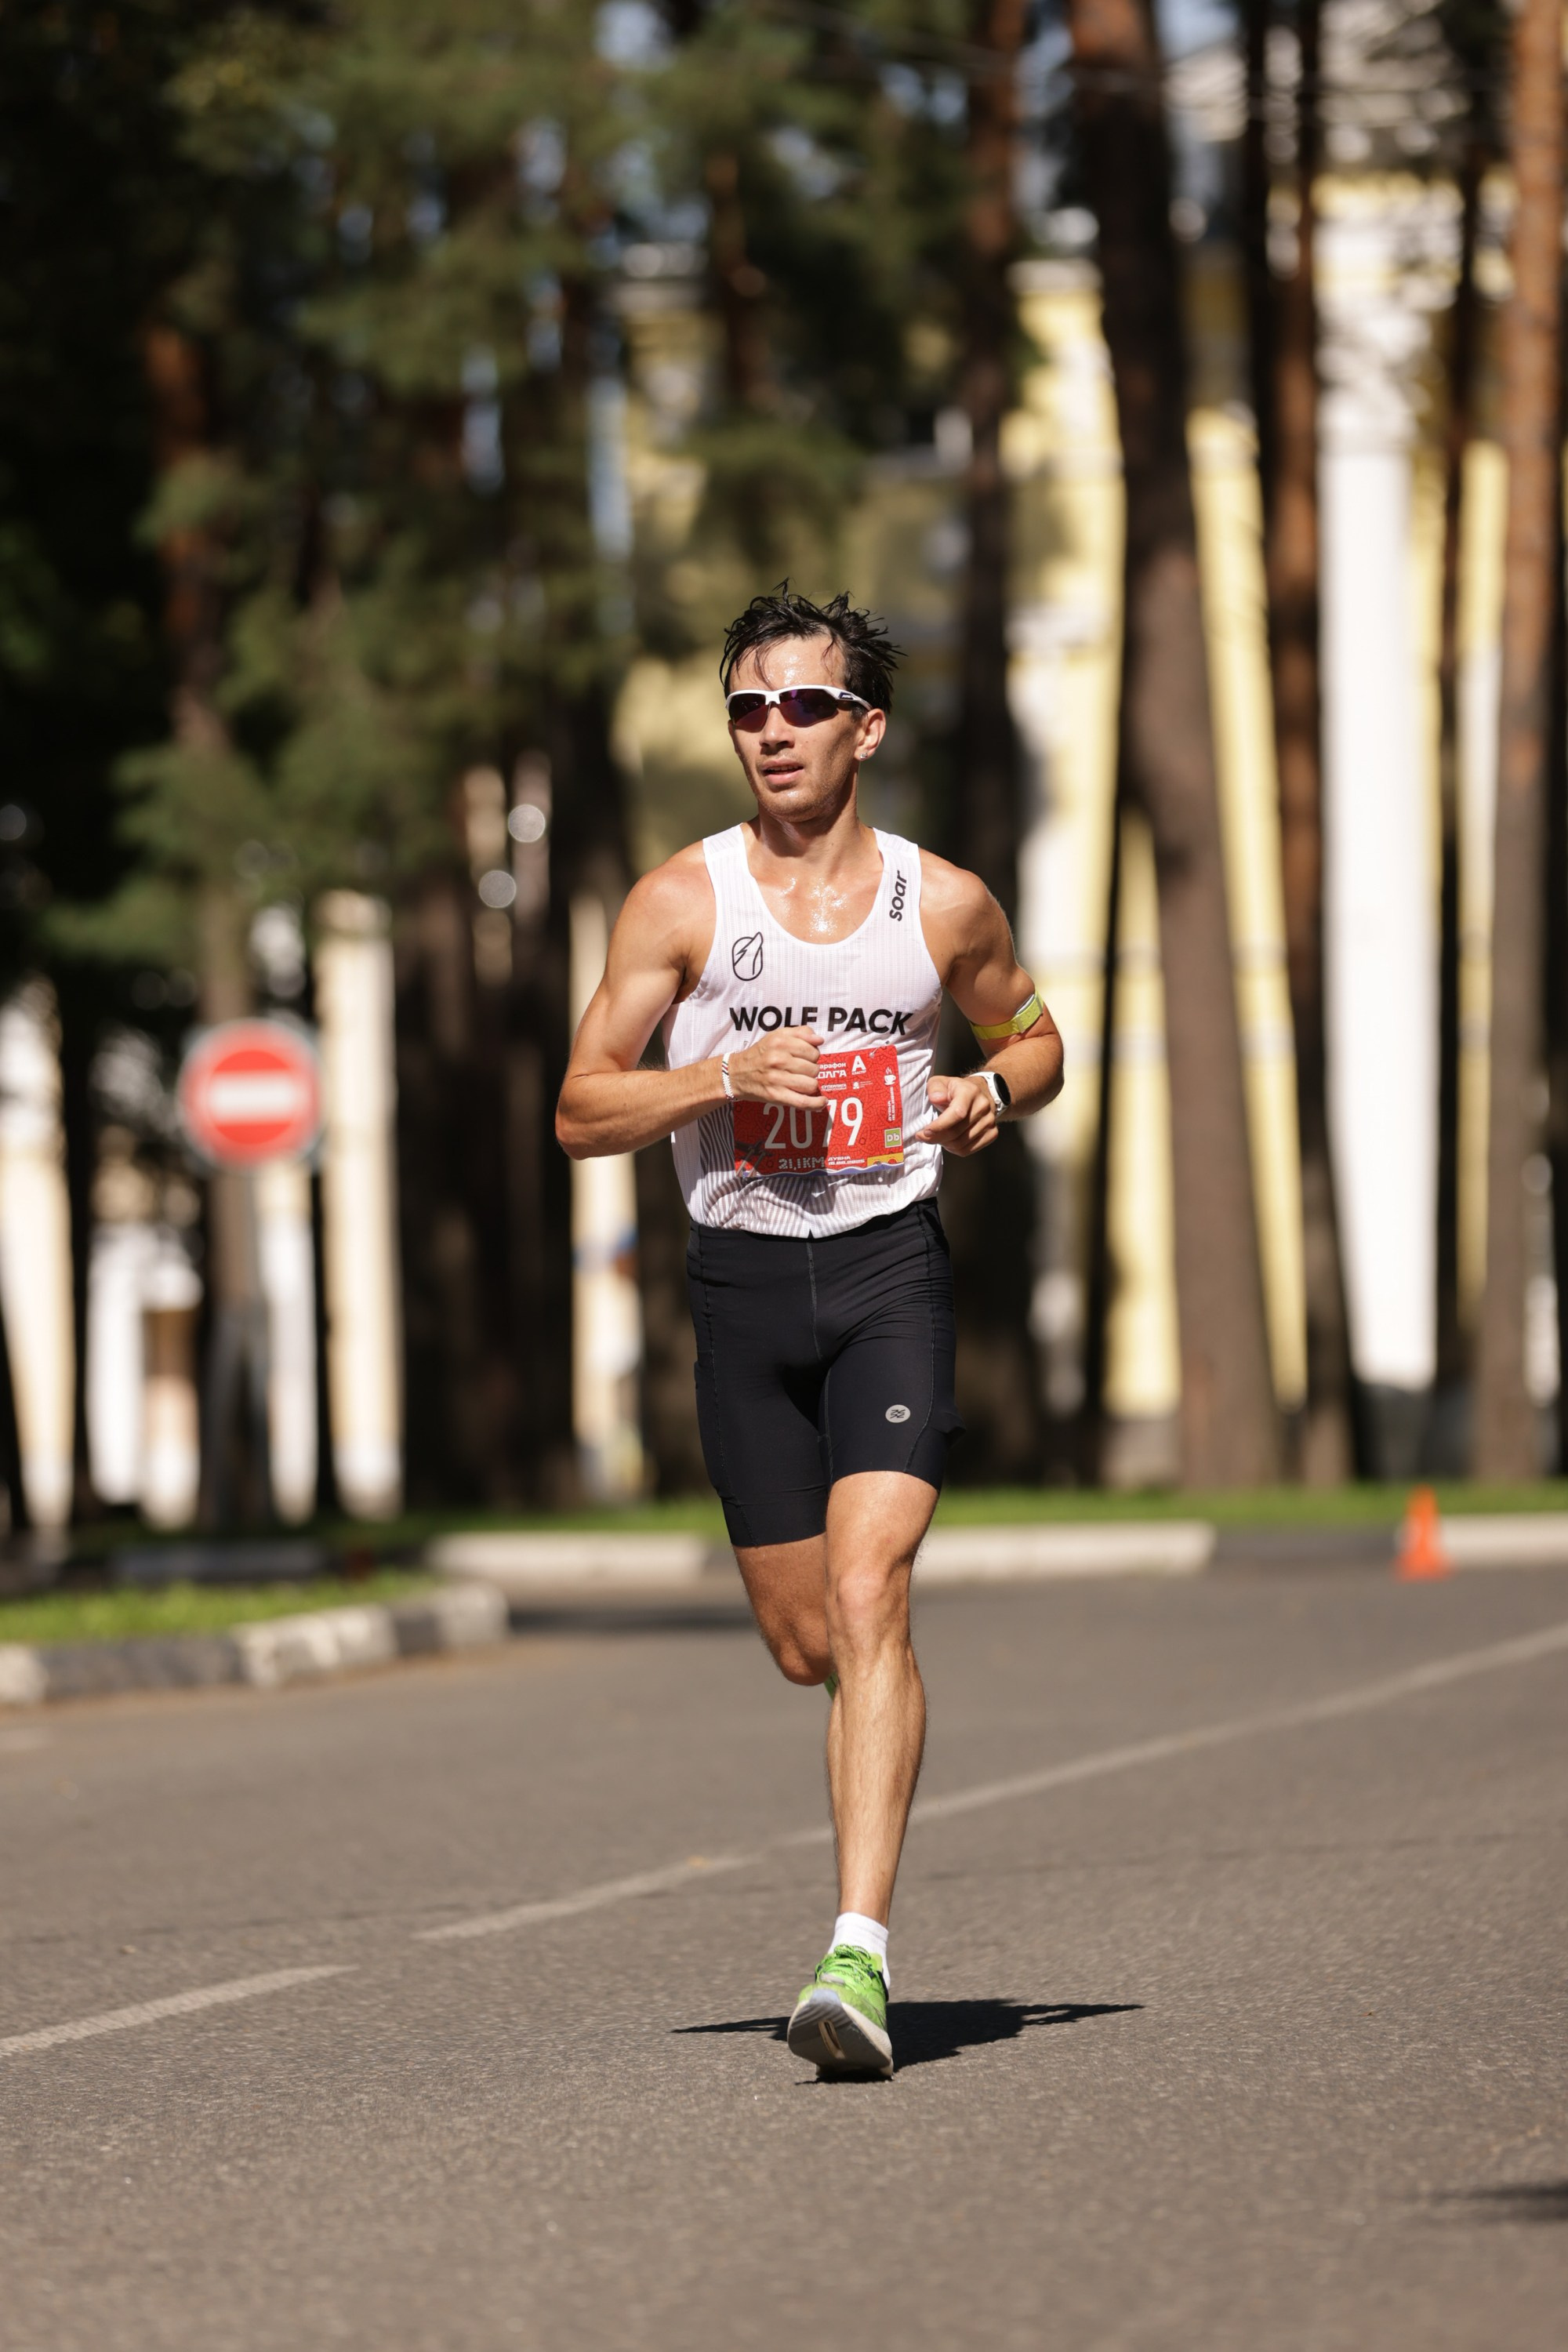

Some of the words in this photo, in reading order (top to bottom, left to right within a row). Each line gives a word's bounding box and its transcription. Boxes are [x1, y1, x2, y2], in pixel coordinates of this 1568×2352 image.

[889, 869, 907, 921] soar
[828, 1006, 913, 1035] PACK
[815, 1069, 848, 1079] ОЛГА
[763, 1097, 863, 1149] 2079
